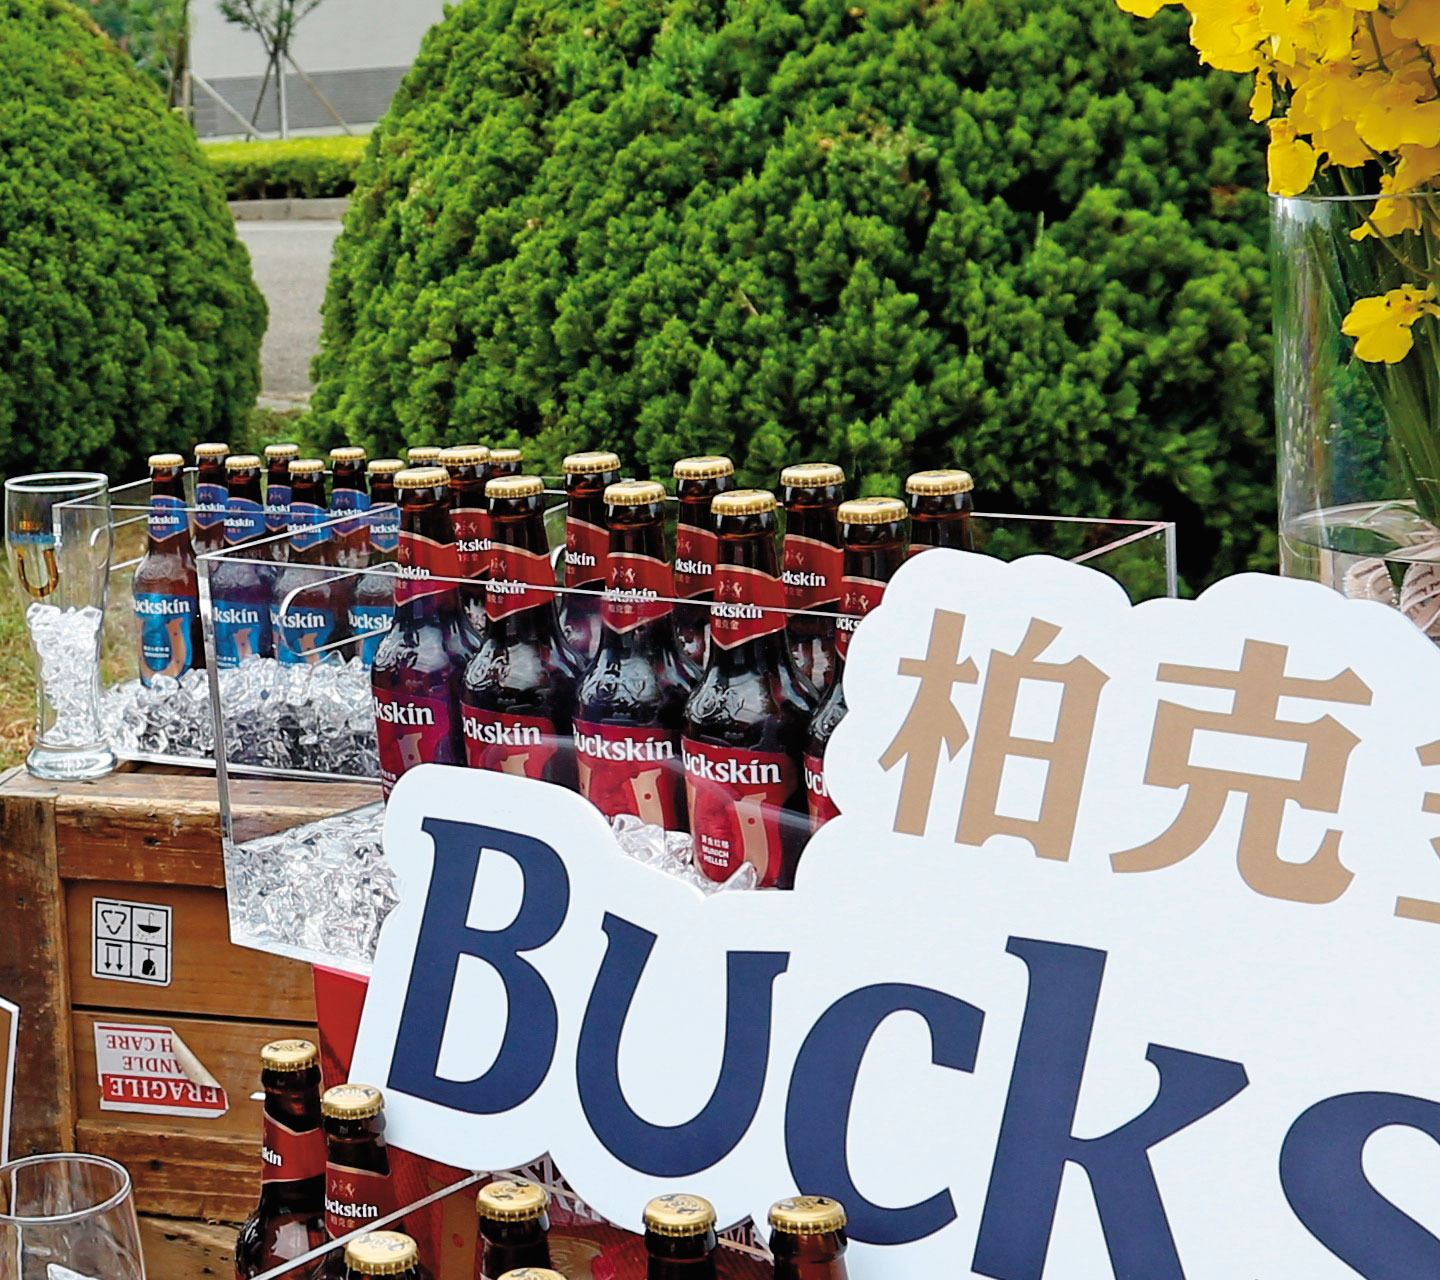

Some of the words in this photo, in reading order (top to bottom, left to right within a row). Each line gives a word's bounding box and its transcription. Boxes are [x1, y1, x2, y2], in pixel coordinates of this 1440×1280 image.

[681, 747, 782, 785] uckskin
[106, 1034, 156, 1052] CARE
[122, 1055, 184, 1074] ANDLE
[109, 1077, 219, 1104] FRAGILE
